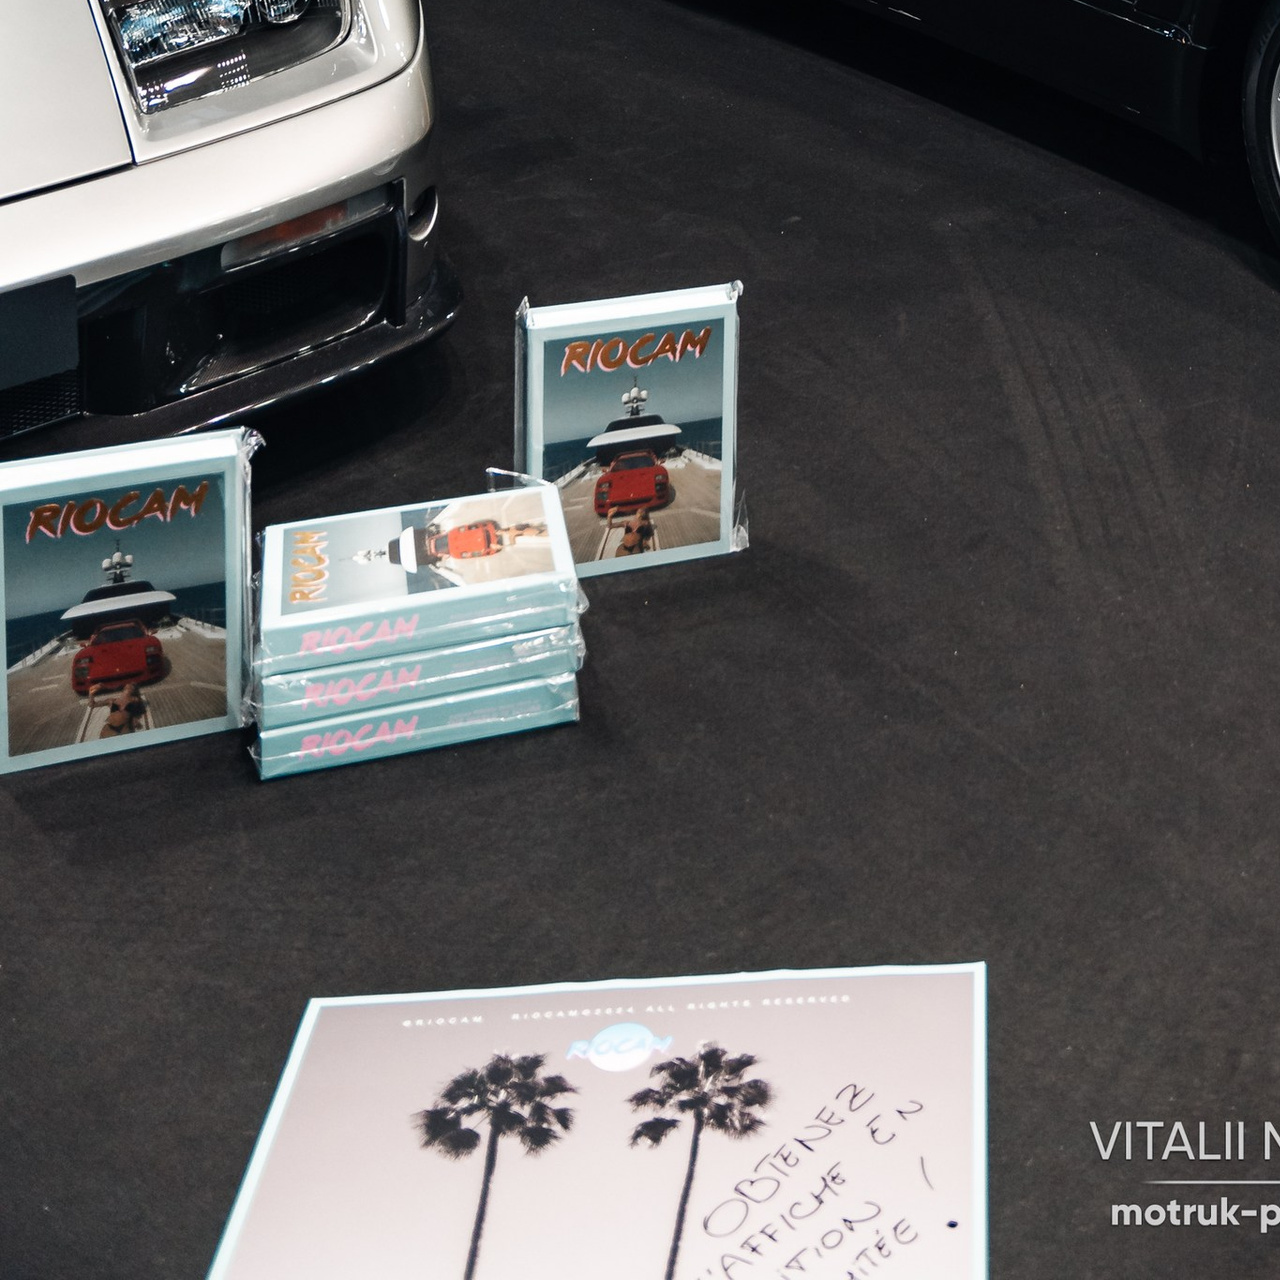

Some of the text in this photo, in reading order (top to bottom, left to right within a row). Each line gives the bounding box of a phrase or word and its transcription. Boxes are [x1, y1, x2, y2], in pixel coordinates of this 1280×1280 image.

[560, 326, 712, 377] RIOCAM
[25, 480, 208, 544] RIOCAM
[288, 529, 330, 605] RIOCAM
[299, 614, 419, 656] RIOCAM
[302, 665, 422, 710] RIOCAM
[300, 715, 419, 759] RIOCAM
[646, 1004, 676, 1014] ALL
[686, 999, 751, 1011] RIGHTS
[762, 993, 851, 1007] RESERVED
[703, 1083, 875, 1237] OBTENEZ
